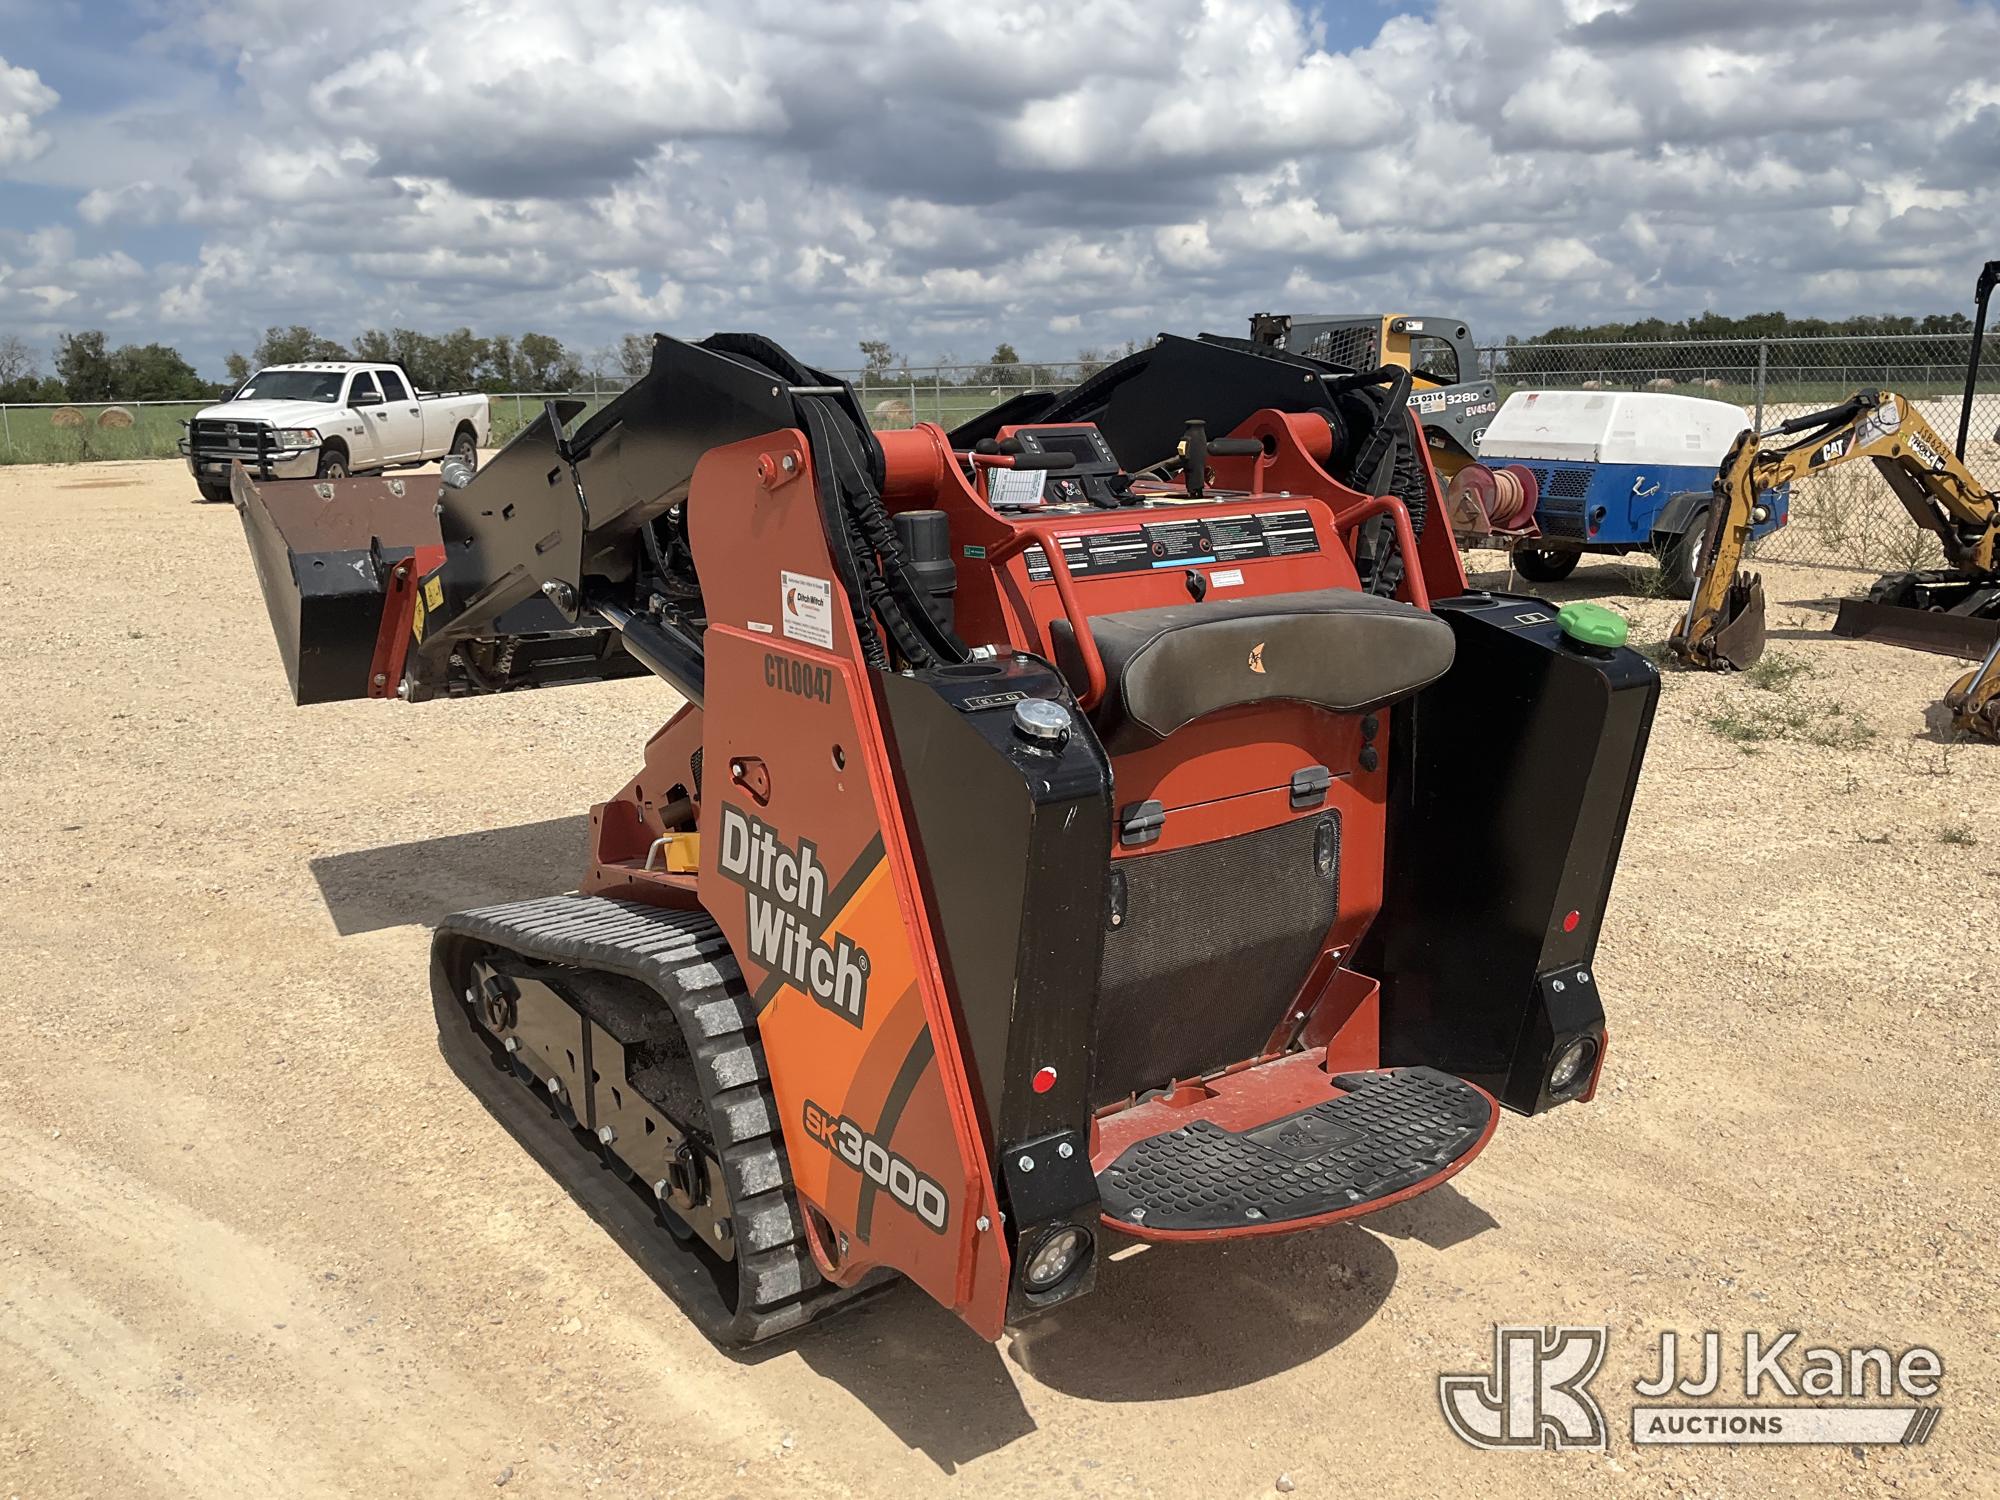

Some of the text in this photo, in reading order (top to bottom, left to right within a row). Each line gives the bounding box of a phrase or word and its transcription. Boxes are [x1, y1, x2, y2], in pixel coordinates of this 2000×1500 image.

[1410, 393, 1444, 404] SS 0216
[1447, 393, 1479, 404] 328D
[1823, 439, 1845, 461] CAT
[1912, 438, 1934, 463] HOLT
[797, 593, 811, 604] Ditch
[764, 653, 832, 705] CTL0047
[721, 809, 824, 918] Ditch
[806, 1105, 946, 1229] SK3000
